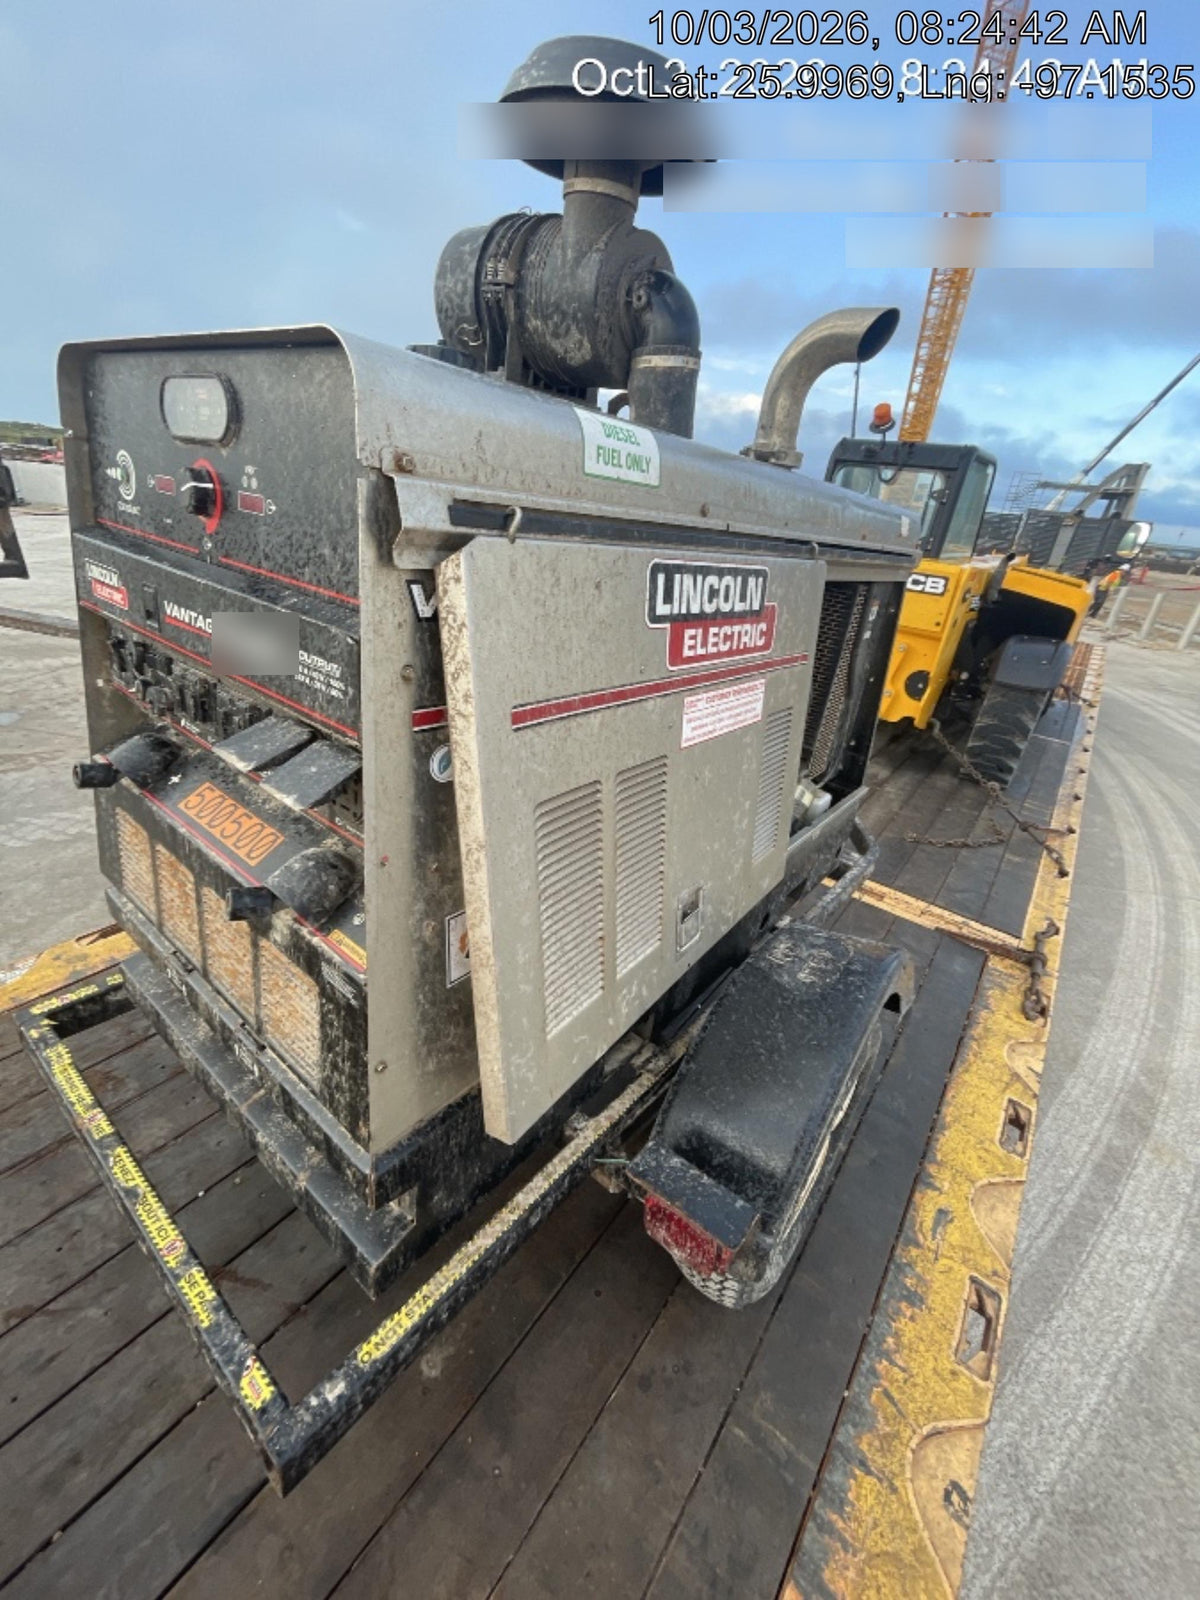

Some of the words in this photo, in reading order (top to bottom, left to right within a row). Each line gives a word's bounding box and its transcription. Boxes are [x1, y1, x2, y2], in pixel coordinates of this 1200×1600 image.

[601, 421, 640, 446] DIESEL
[596, 444, 623, 468] FUEL
[626, 452, 651, 474] ONLY
[85, 561, 119, 587] LINCOLN
[906, 574, 947, 595] CB
[96, 582, 125, 605] ELECTRIC
[654, 572, 765, 617] LINCOLN
[163, 600, 212, 633] VANTAG
[683, 621, 767, 658] ELECTRIC
[184, 786, 280, 861] 500500
[184, 1273, 200, 1292] SE
[373, 1320, 403, 1352] NOT
